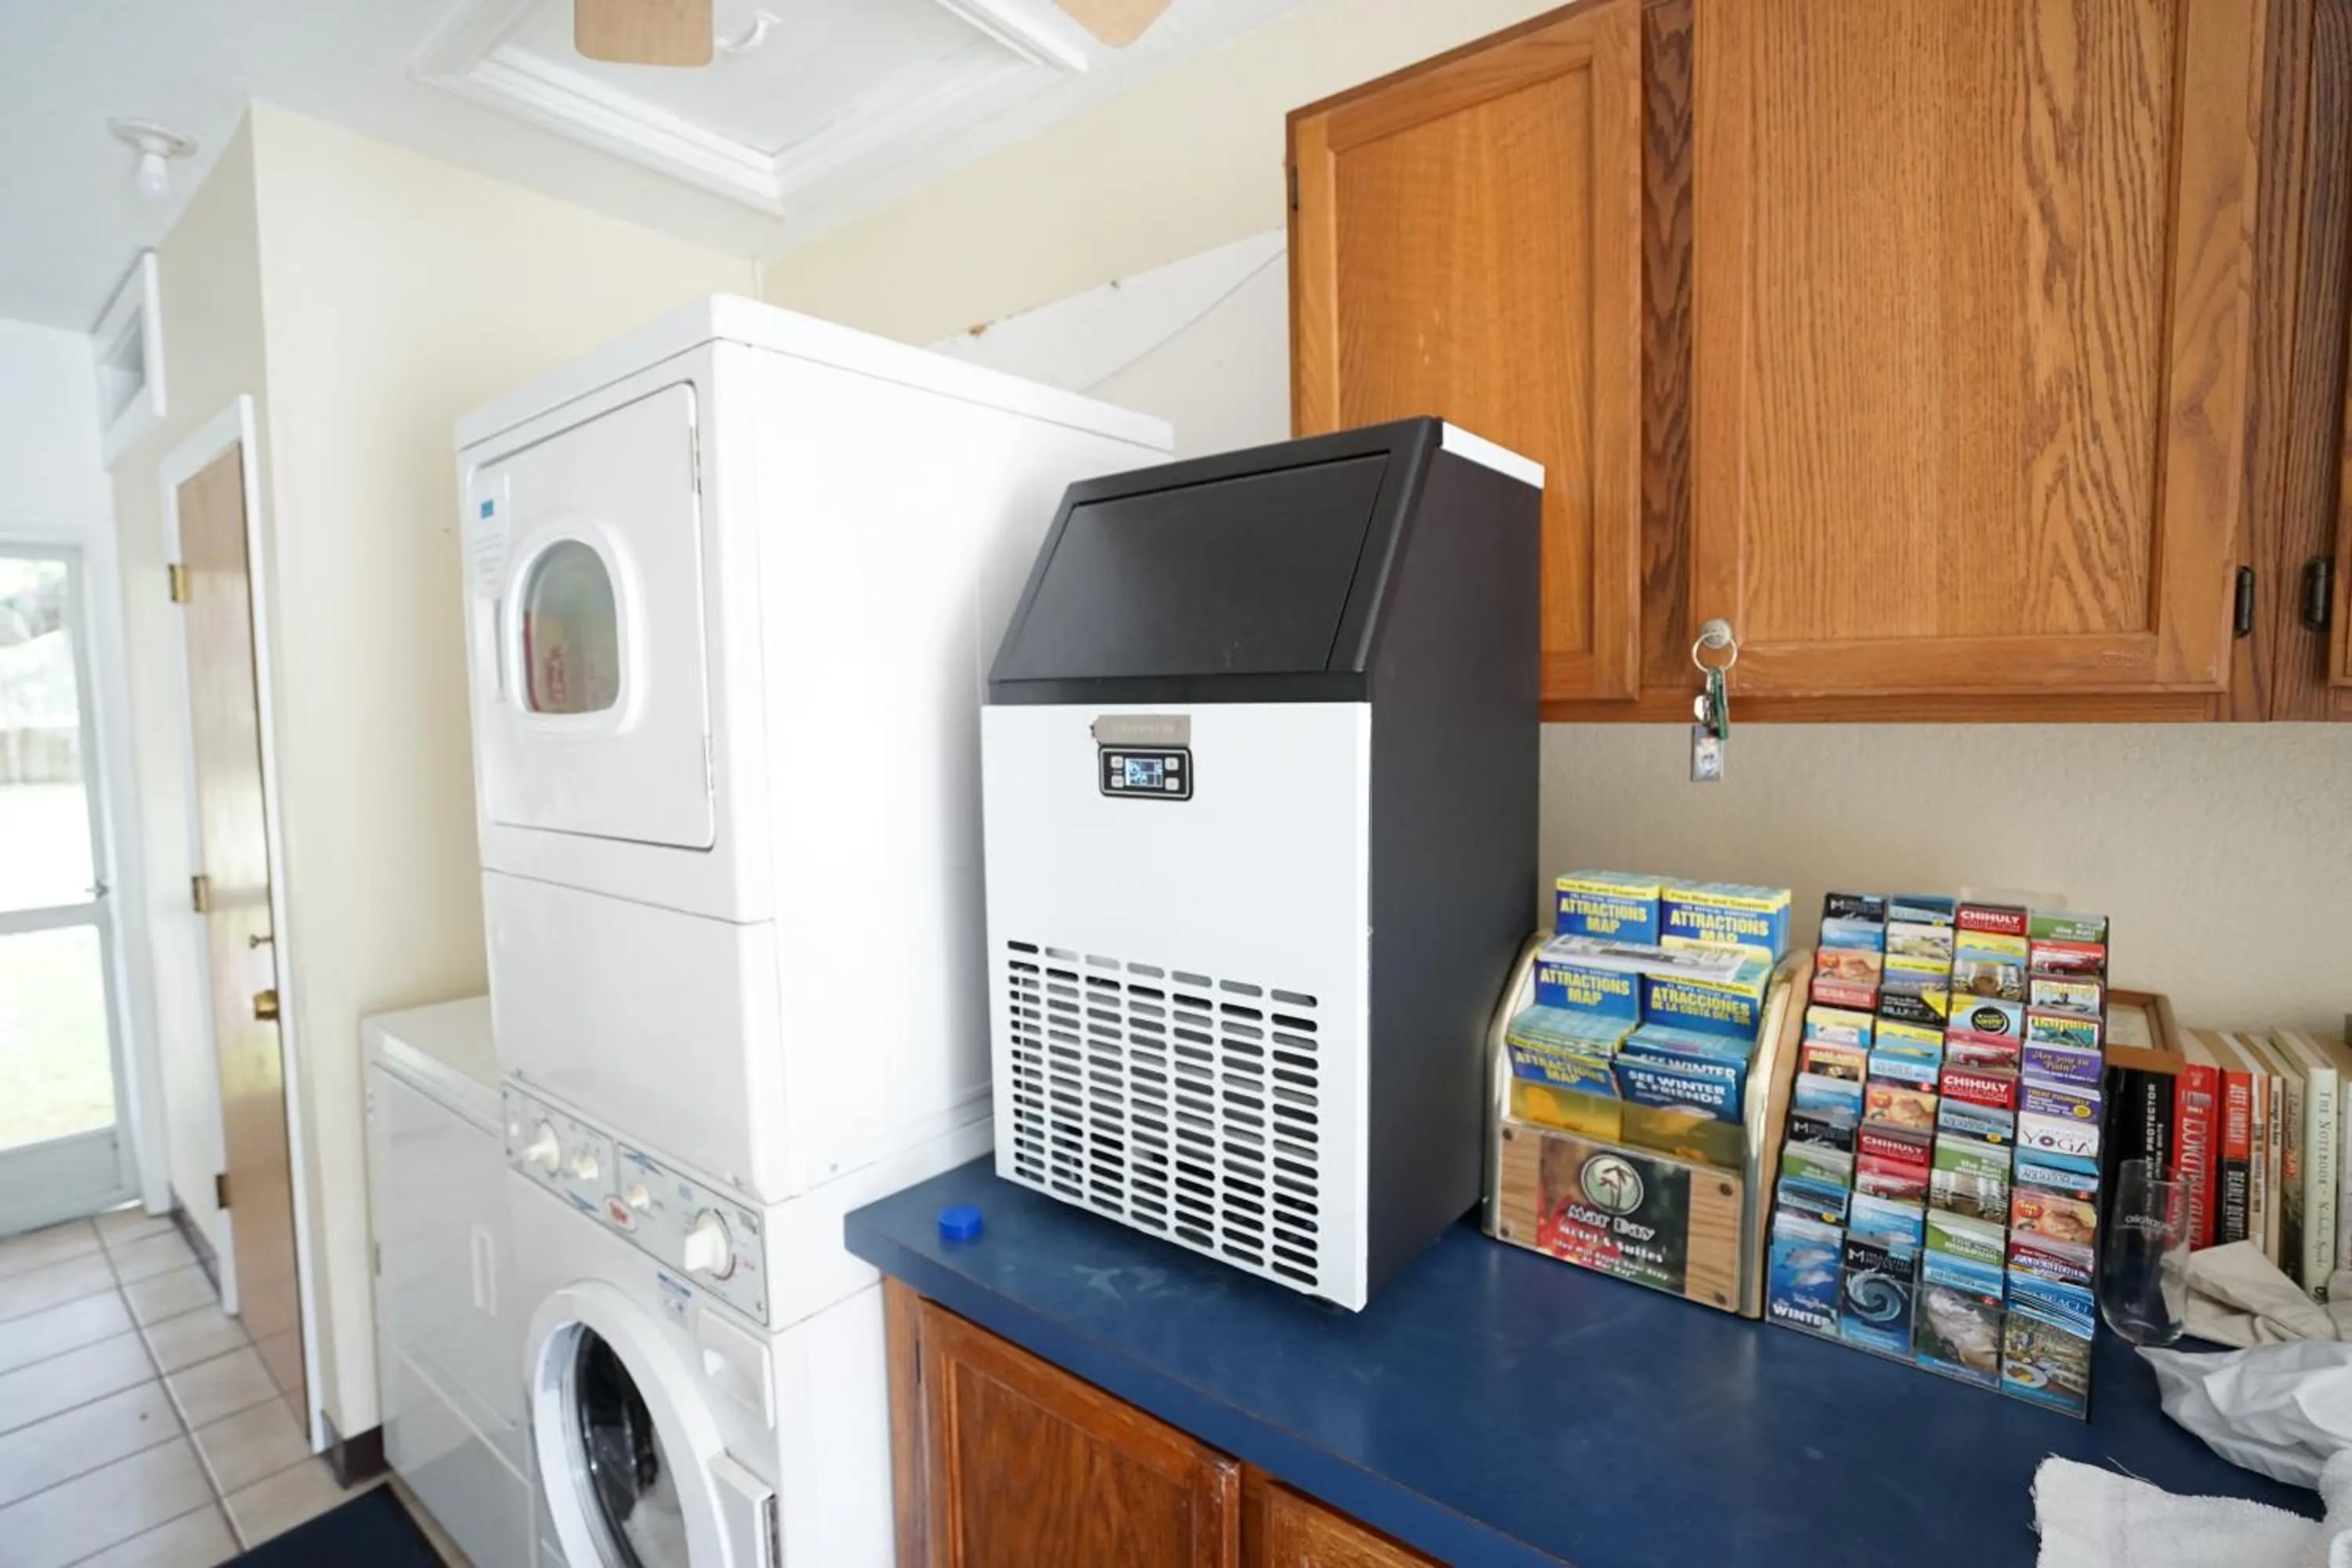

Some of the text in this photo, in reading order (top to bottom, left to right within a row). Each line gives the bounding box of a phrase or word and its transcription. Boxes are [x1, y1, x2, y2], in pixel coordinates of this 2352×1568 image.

[1559, 898, 1647, 923] ATTRACTIONS
[1669, 909, 1769, 937] ATTRACTIONS
[1960, 909, 2020, 924] CHIHULY
[1586, 916, 1621, 934] MAP
[1700, 929, 1738, 943] MAP
[1541, 967, 1631, 996] ATTRACTIONS
[1567, 987, 1603, 1007] MAP
[1652, 986, 1751, 1014] ATRACCIONES
[1515, 1051, 1606, 1083] ATTRACTIONS
[1545, 1067, 1581, 1084] MAP
[1628, 1069, 1655, 1083] SEE
[1657, 1074, 1726, 1096] WINTER
[1650, 1083, 1724, 1105] FRIENDS
[1944, 1075, 2008, 1092] CHIHULY
[2229, 1083, 2247, 1145] JEFF LINDSAY
[2319, 1091, 2333, 1115] THE
[2145, 1083, 2157, 1151] PROTECTOR
[1863, 1136, 1922, 1155] CHIHULY
[2023, 1129, 2092, 1156] YOGA
[2318, 1120, 2332, 1186] NOTEBOOK
[2180, 1117, 2207, 1196] BALDACCI
[2227, 1170, 2246, 1203] DEARLY
